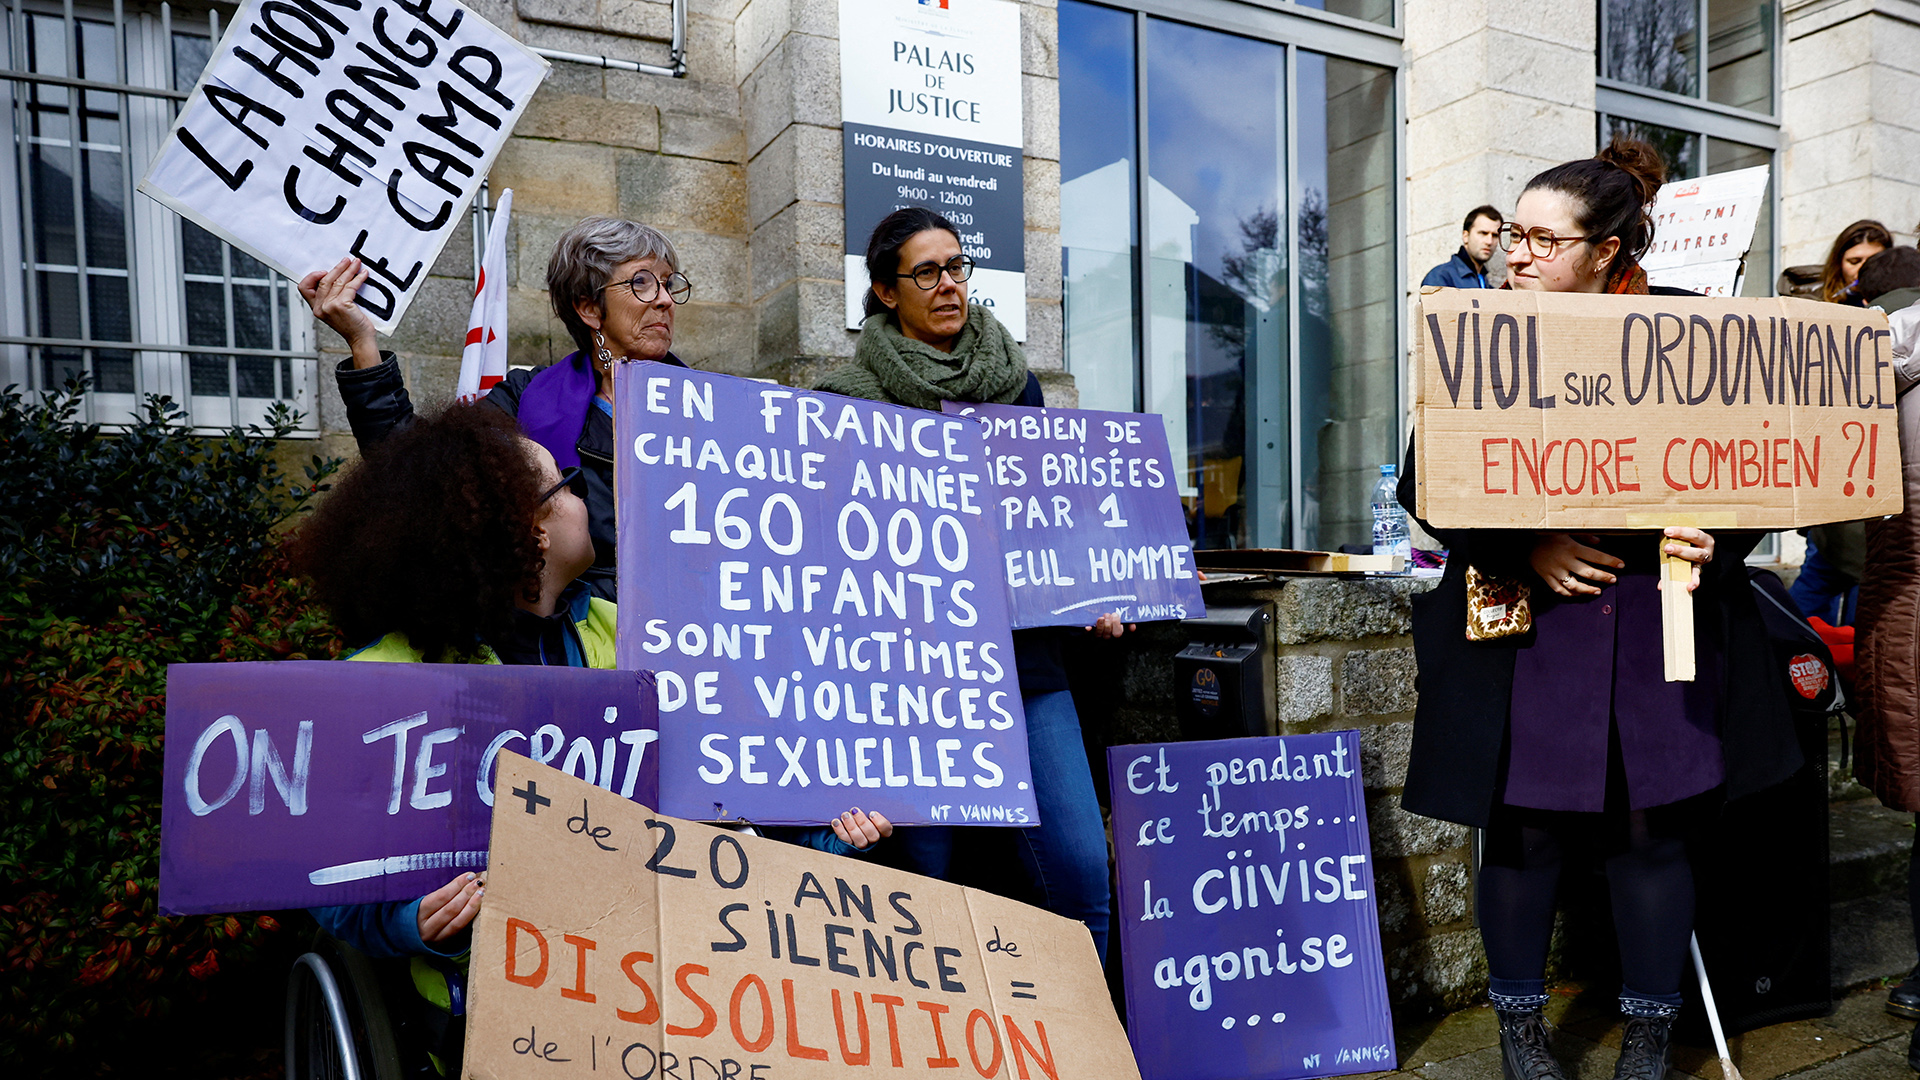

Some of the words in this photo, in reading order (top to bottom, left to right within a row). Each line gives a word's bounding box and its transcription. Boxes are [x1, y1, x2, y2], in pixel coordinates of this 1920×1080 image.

[893, 41, 975, 75] PALAIS
[925, 74, 945, 90] DE
[283, 0, 464, 225] CHANGE
[888, 88, 981, 124] JUSTICE
[177, 83, 285, 191] LA
[387, 45, 515, 231] CAMP
[854, 132, 921, 155] HORAIRES
[924, 142, 1012, 168] D'OUVERTURE
[872, 162, 891, 177] Du
[894, 164, 925, 182] lundi
[928, 172, 943, 183] au
[946, 173, 997, 191] vendredi
[897, 185, 927, 201] 9h00
[939, 191, 973, 207] 12h00
[1650, 233, 1728, 254] DIATRES
[1564, 372, 1615, 407] SUR
[1621, 312, 1895, 410] ORDONNANCE
[647, 377, 714, 422] EN
[760, 389, 969, 463] FRANCE
[1103, 420, 1141, 444] DE
[634, 432, 826, 490] CHAQUE
[851, 459, 982, 515] ANNÉE
[1482, 436, 1641, 496] ENCORE
[1841, 420, 1878, 499] ?!
[664, 481, 803, 556] 160
[837, 501, 969, 573] 000
[1000, 494, 1074, 530] PAR
[1098, 492, 1128, 528] 1
[1005, 548, 1075, 588] EUL
[1088, 544, 1193, 583] HOMME
[720, 561, 978, 628] ENFANTS
[1138, 603, 1187, 619] VANNES
[642, 619, 773, 661] SONT
[1791, 660, 1822, 677] STOP
[656, 670, 722, 715] DE
[183, 713, 314, 818] ON
[362, 710, 466, 815] TE
[698, 733, 1029, 791] SEXUELLES.
[1126, 746, 1179, 795] Et
[1206, 735, 1355, 811] pendant
[931, 804, 952, 820] NT
[960, 804, 1029, 824] VANNES
[1136, 816, 1176, 846] ce
[512, 779, 552, 815] +
[567, 798, 619, 852] de
[644, 818, 749, 891] 20
[793, 871, 923, 937] ANS
[985, 925, 1022, 959] de
[1140, 879, 1174, 921] la
[1010, 979, 1038, 1001] =
[1153, 928, 1354, 1011] agonise
[505, 916, 1059, 1080] DISSOLUTION
[512, 1025, 572, 1062] de
[1303, 1053, 1321, 1069] NT
[1335, 1044, 1390, 1066] VANNES
